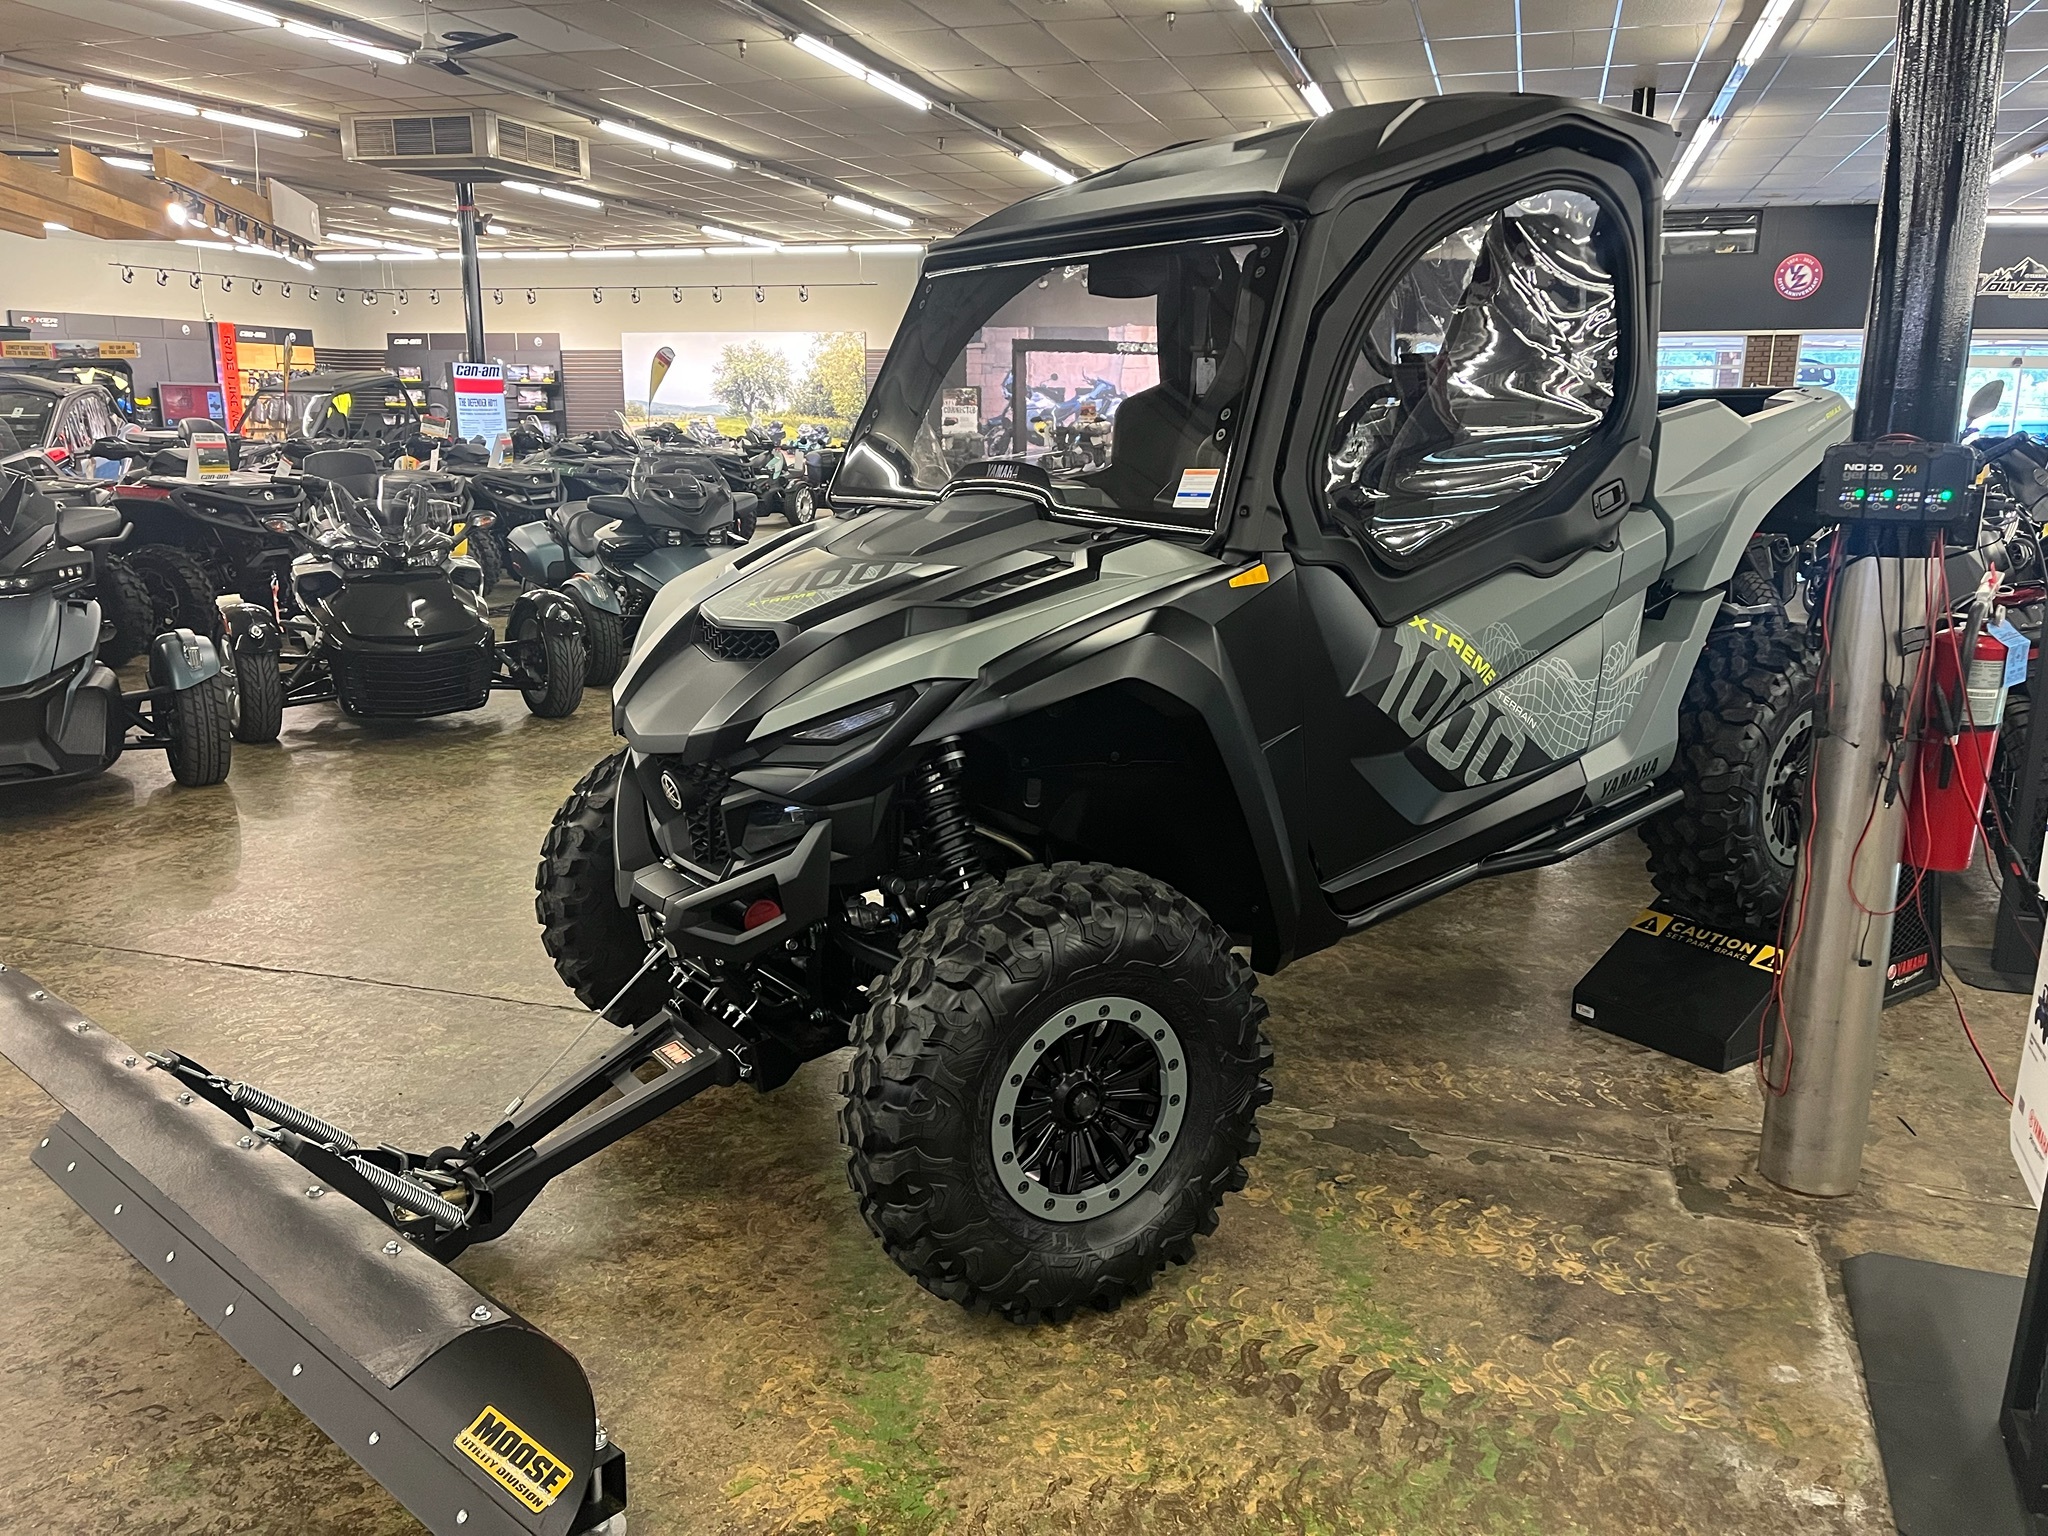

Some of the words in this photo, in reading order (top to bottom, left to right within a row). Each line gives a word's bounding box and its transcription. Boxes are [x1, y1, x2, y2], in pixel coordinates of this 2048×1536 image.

[1784, 277, 1819, 296] ANNIVERSARY
[1976, 276, 2048, 292] OLVER
[21, 316, 58, 324] RYKER
[223, 335, 235, 371] RIDE
[456, 364, 500, 378] can-am
[227, 376, 239, 407] LIKE
[986, 463, 1020, 479] YAMAHA
[1844, 463, 1884, 472] NOCO
[747, 591, 818, 607] XTREME
[1408, 614, 1498, 687] XTREME
[1497, 691, 1538, 729] TERRAIN
[1601, 757, 1659, 799] YAMAHA
[1665, 931, 1685, 943] SET
[1685, 937, 1712, 950] PARK
[1713, 946, 1749, 961] BRAKE
[1671, 922, 1757, 955] CAUTION
[1897, 953, 1928, 977] YAMAHA
[471, 1412, 567, 1494] MOOSE
[461, 1437, 496, 1468] UTILITY
[496, 1467, 544, 1508] DIVISION
